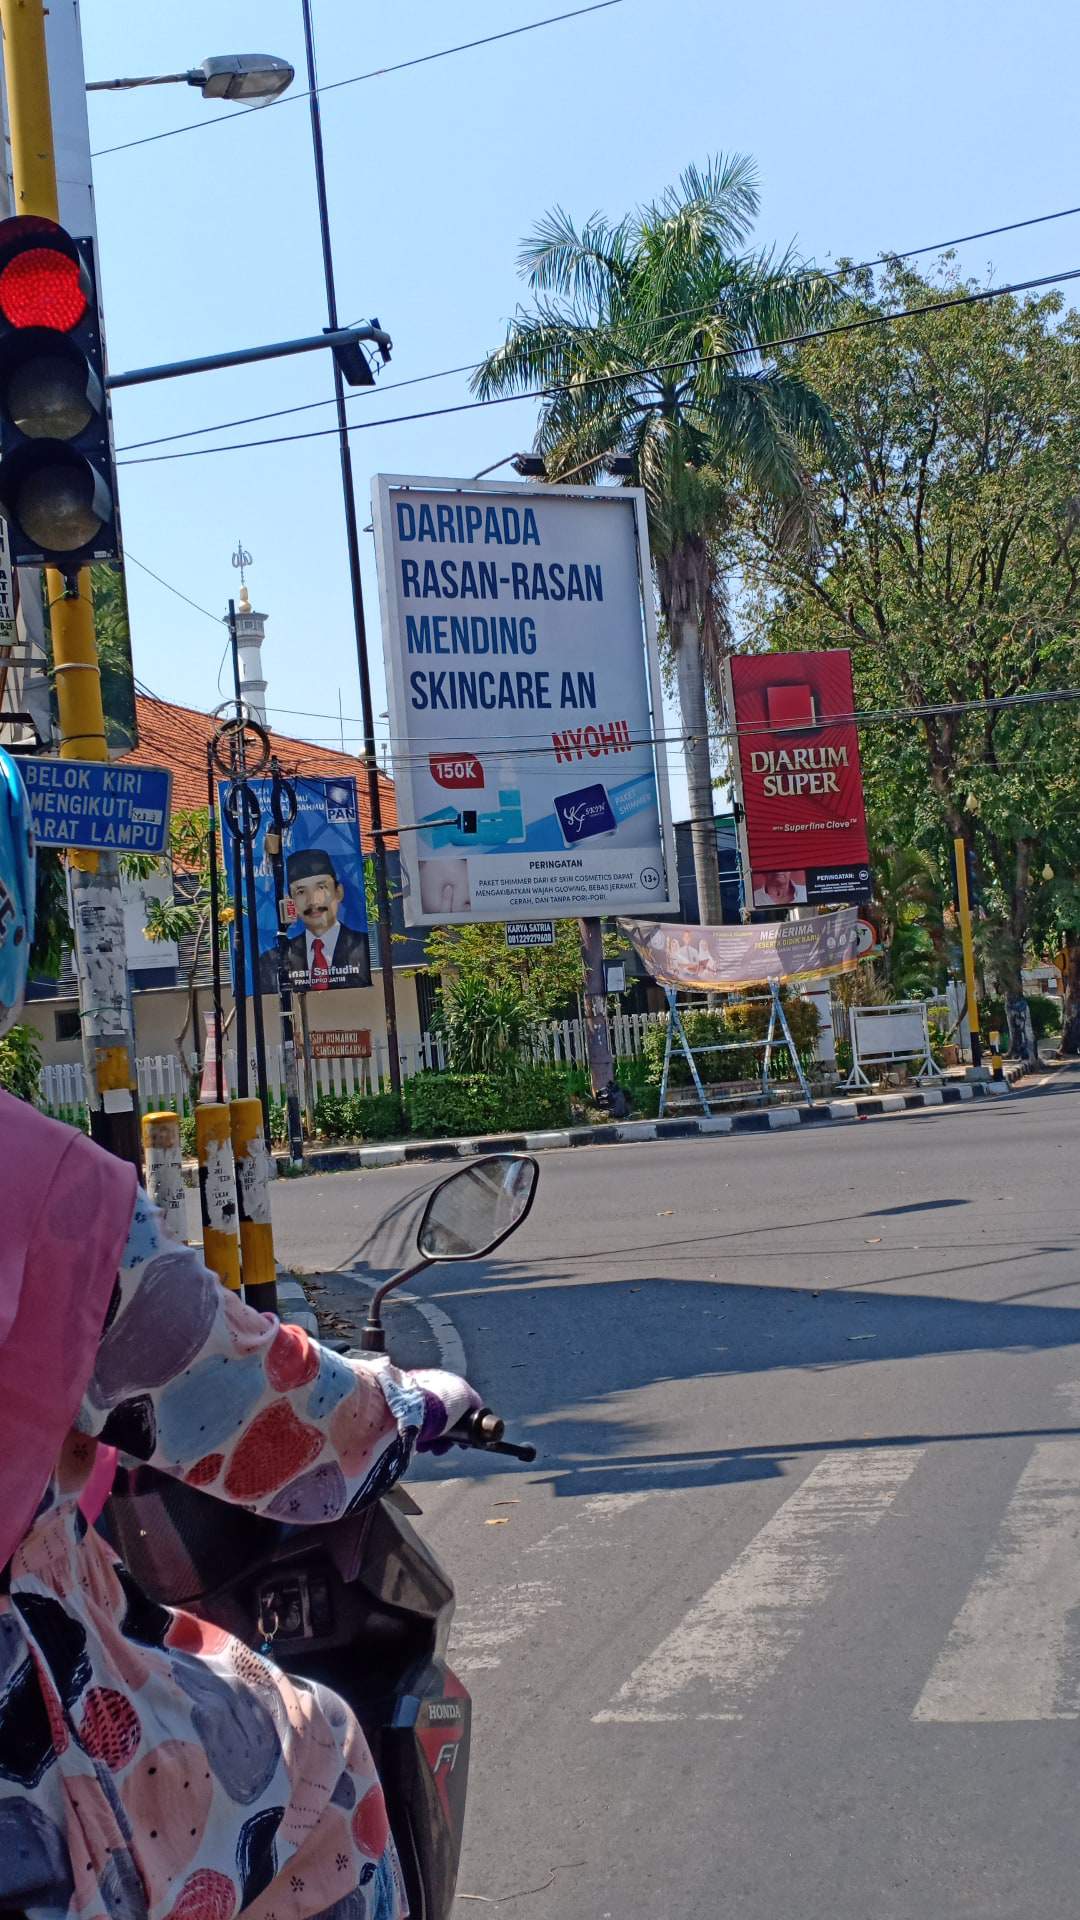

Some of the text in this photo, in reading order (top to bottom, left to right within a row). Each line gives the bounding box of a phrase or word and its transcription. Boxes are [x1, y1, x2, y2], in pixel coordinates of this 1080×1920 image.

[397, 502, 541, 546] DARIPADA
[401, 559, 604, 601] RASAN-RASAN
[406, 615, 537, 655] MENDING
[410, 671, 596, 710] SKINCARE AN
[750, 746, 849, 774] DJARUM
[436, 761, 477, 779] 150K
[25, 765, 142, 794] BELOK KIRI
[763, 771, 841, 797] SUPER
[30, 792, 134, 819] MENGIKUTI
[327, 808, 356, 820] PAN
[91, 822, 158, 846] LAMPU
[784, 821, 825, 832] Superfine
[529, 859, 583, 870] PERINGATAN
[479, 879, 499, 887] PAKET
[500, 877, 532, 886] SHIMMER
[533, 876, 549, 884] DARI
[574, 874, 612, 882] COSMETICS
[643, 874, 657, 883] 13+
[475, 888, 531, 897] MENGAKIBATKAN
[507, 923, 551, 933] KARYA SATRIA
[760, 925, 814, 940] MENERIMA
[313, 964, 359, 976] Saifudin
[428, 1704, 461, 1720] HONDA
